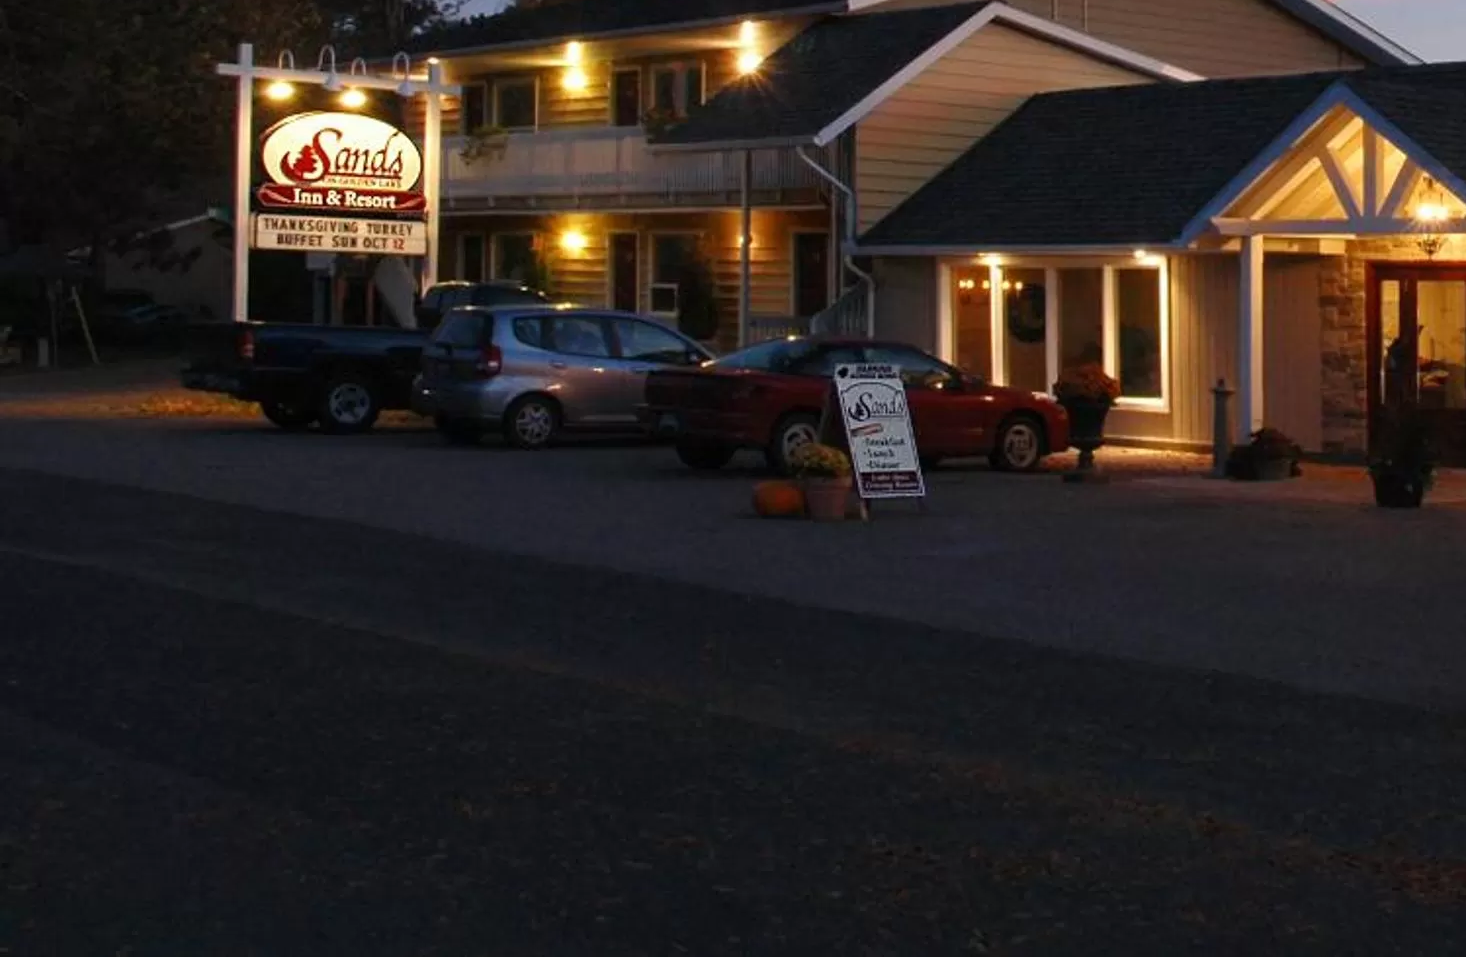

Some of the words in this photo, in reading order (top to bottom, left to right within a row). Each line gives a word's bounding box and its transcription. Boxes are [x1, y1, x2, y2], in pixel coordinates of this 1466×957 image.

[280, 128, 403, 183] Sands
[294, 189, 322, 205] Inn
[326, 189, 340, 205] &
[344, 190, 396, 209] Resort
[263, 218, 359, 234] THANKSGIVING
[367, 223, 413, 236] TURKEY
[277, 233, 323, 247] BUFFET
[332, 235, 357, 248] SUN
[362, 237, 388, 249] OCT
[393, 238, 405, 250] 12
[848, 391, 905, 422] Sands
